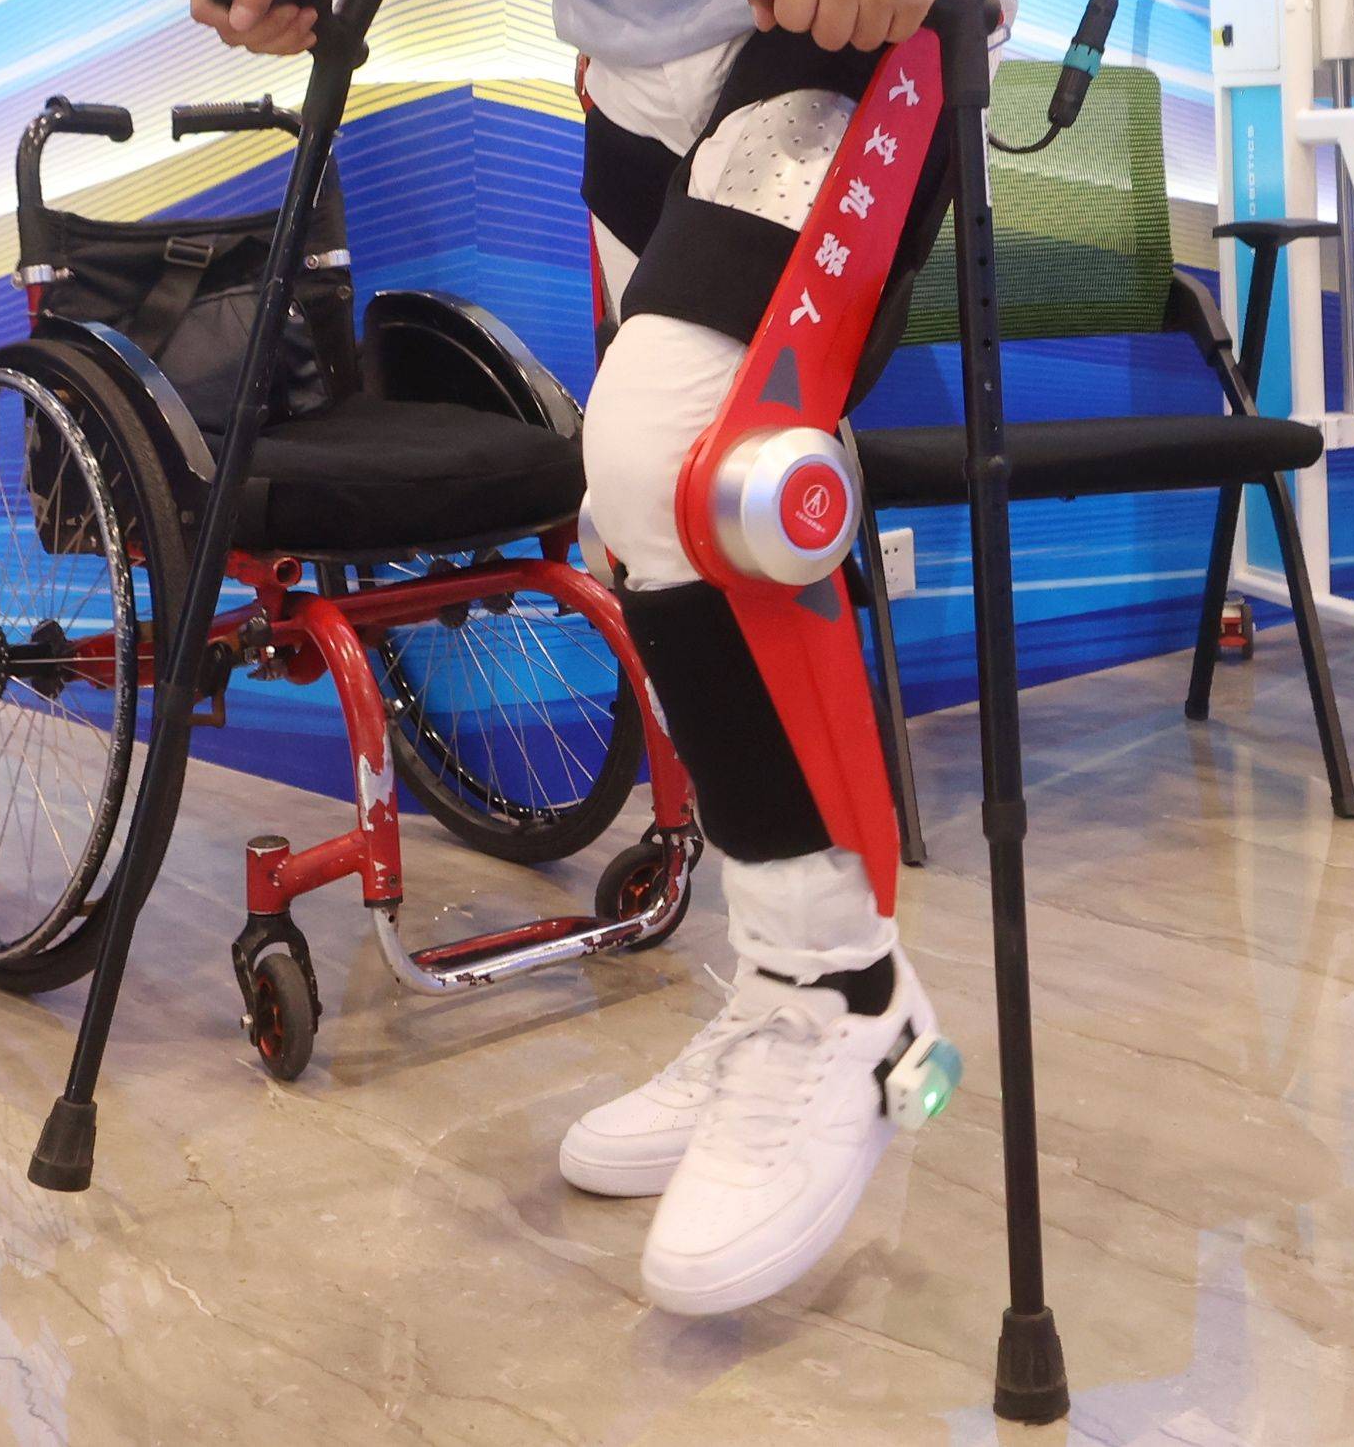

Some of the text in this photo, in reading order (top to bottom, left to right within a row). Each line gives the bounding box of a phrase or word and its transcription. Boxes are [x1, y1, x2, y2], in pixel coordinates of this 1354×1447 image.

[789, 67, 921, 328] 大艾机器人
